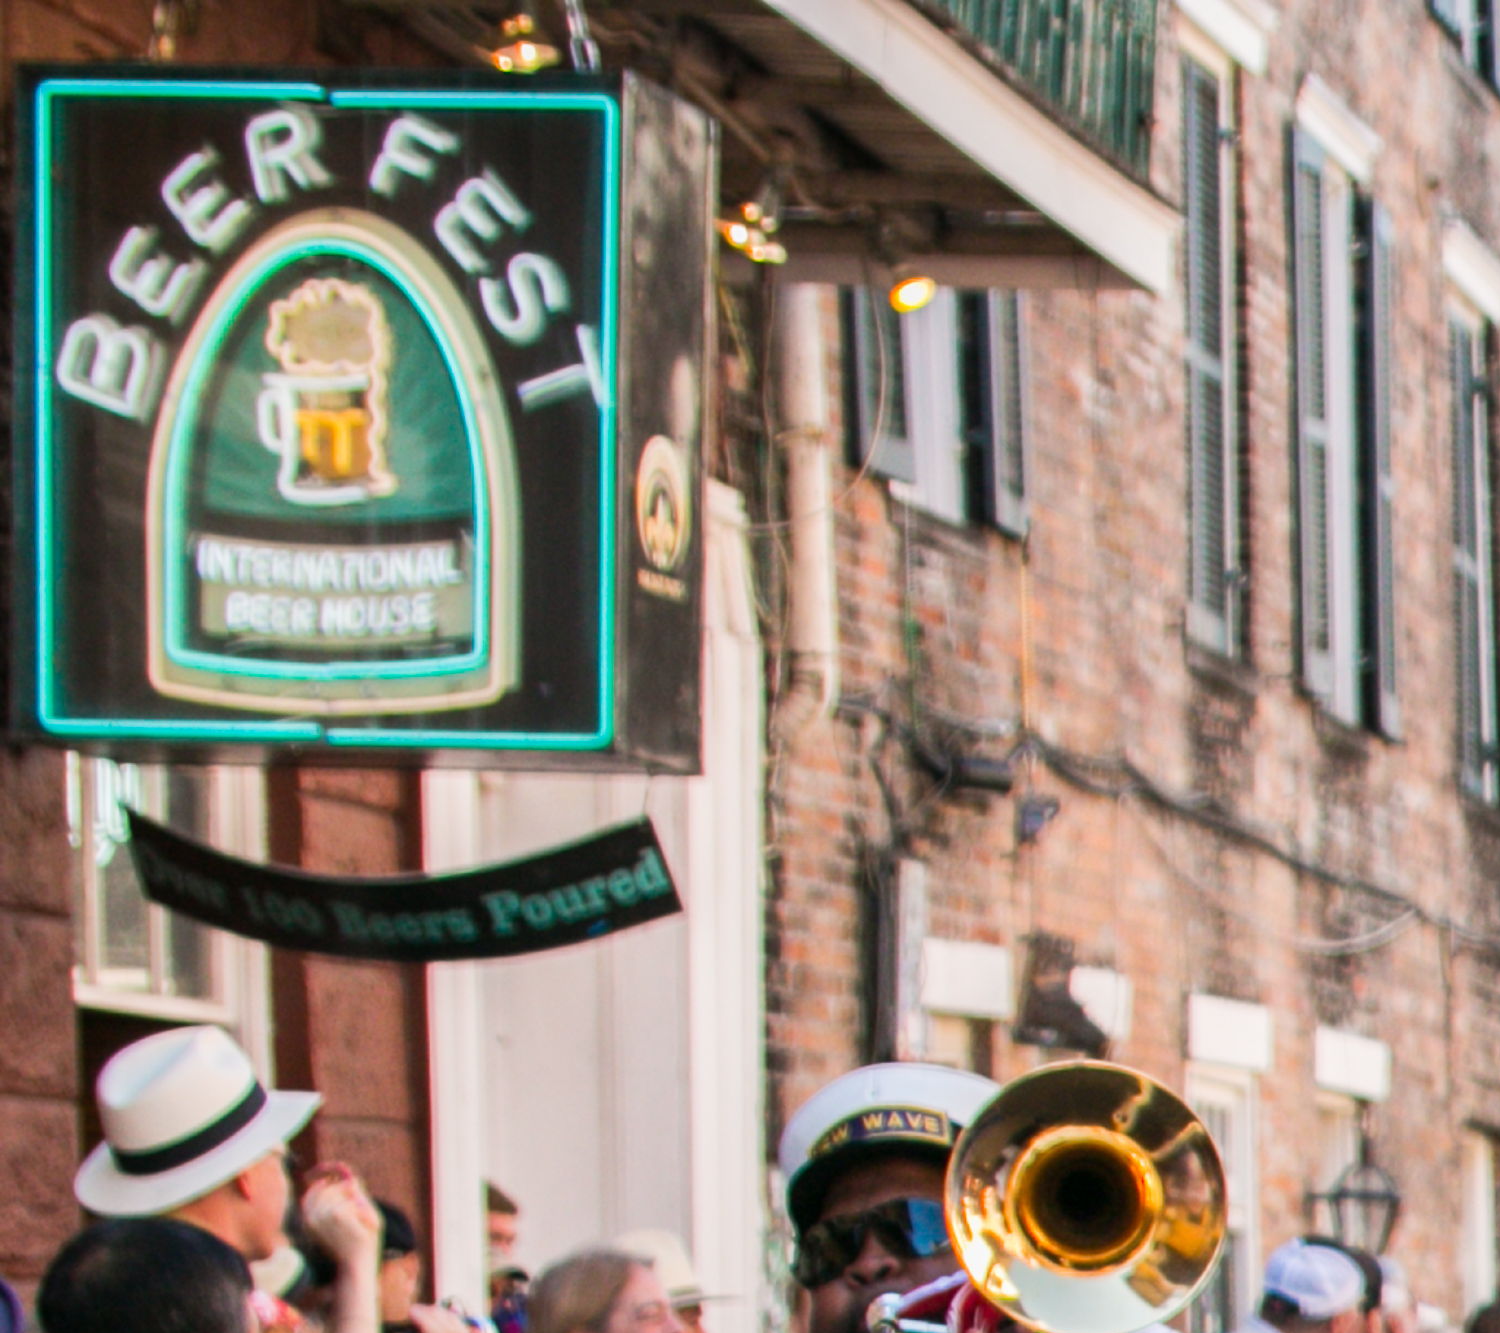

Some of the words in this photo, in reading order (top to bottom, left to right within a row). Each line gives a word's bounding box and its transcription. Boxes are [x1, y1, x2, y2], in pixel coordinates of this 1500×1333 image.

[56, 107, 333, 422] BEER
[369, 112, 613, 412] FEST
[197, 538, 465, 592] INTERNATIONAL
[225, 590, 317, 636] BEER
[320, 592, 437, 637] HOUSE
[327, 897, 479, 944] Beers
[479, 846, 670, 933] Poured
[863, 1111, 940, 1134] WAVE
